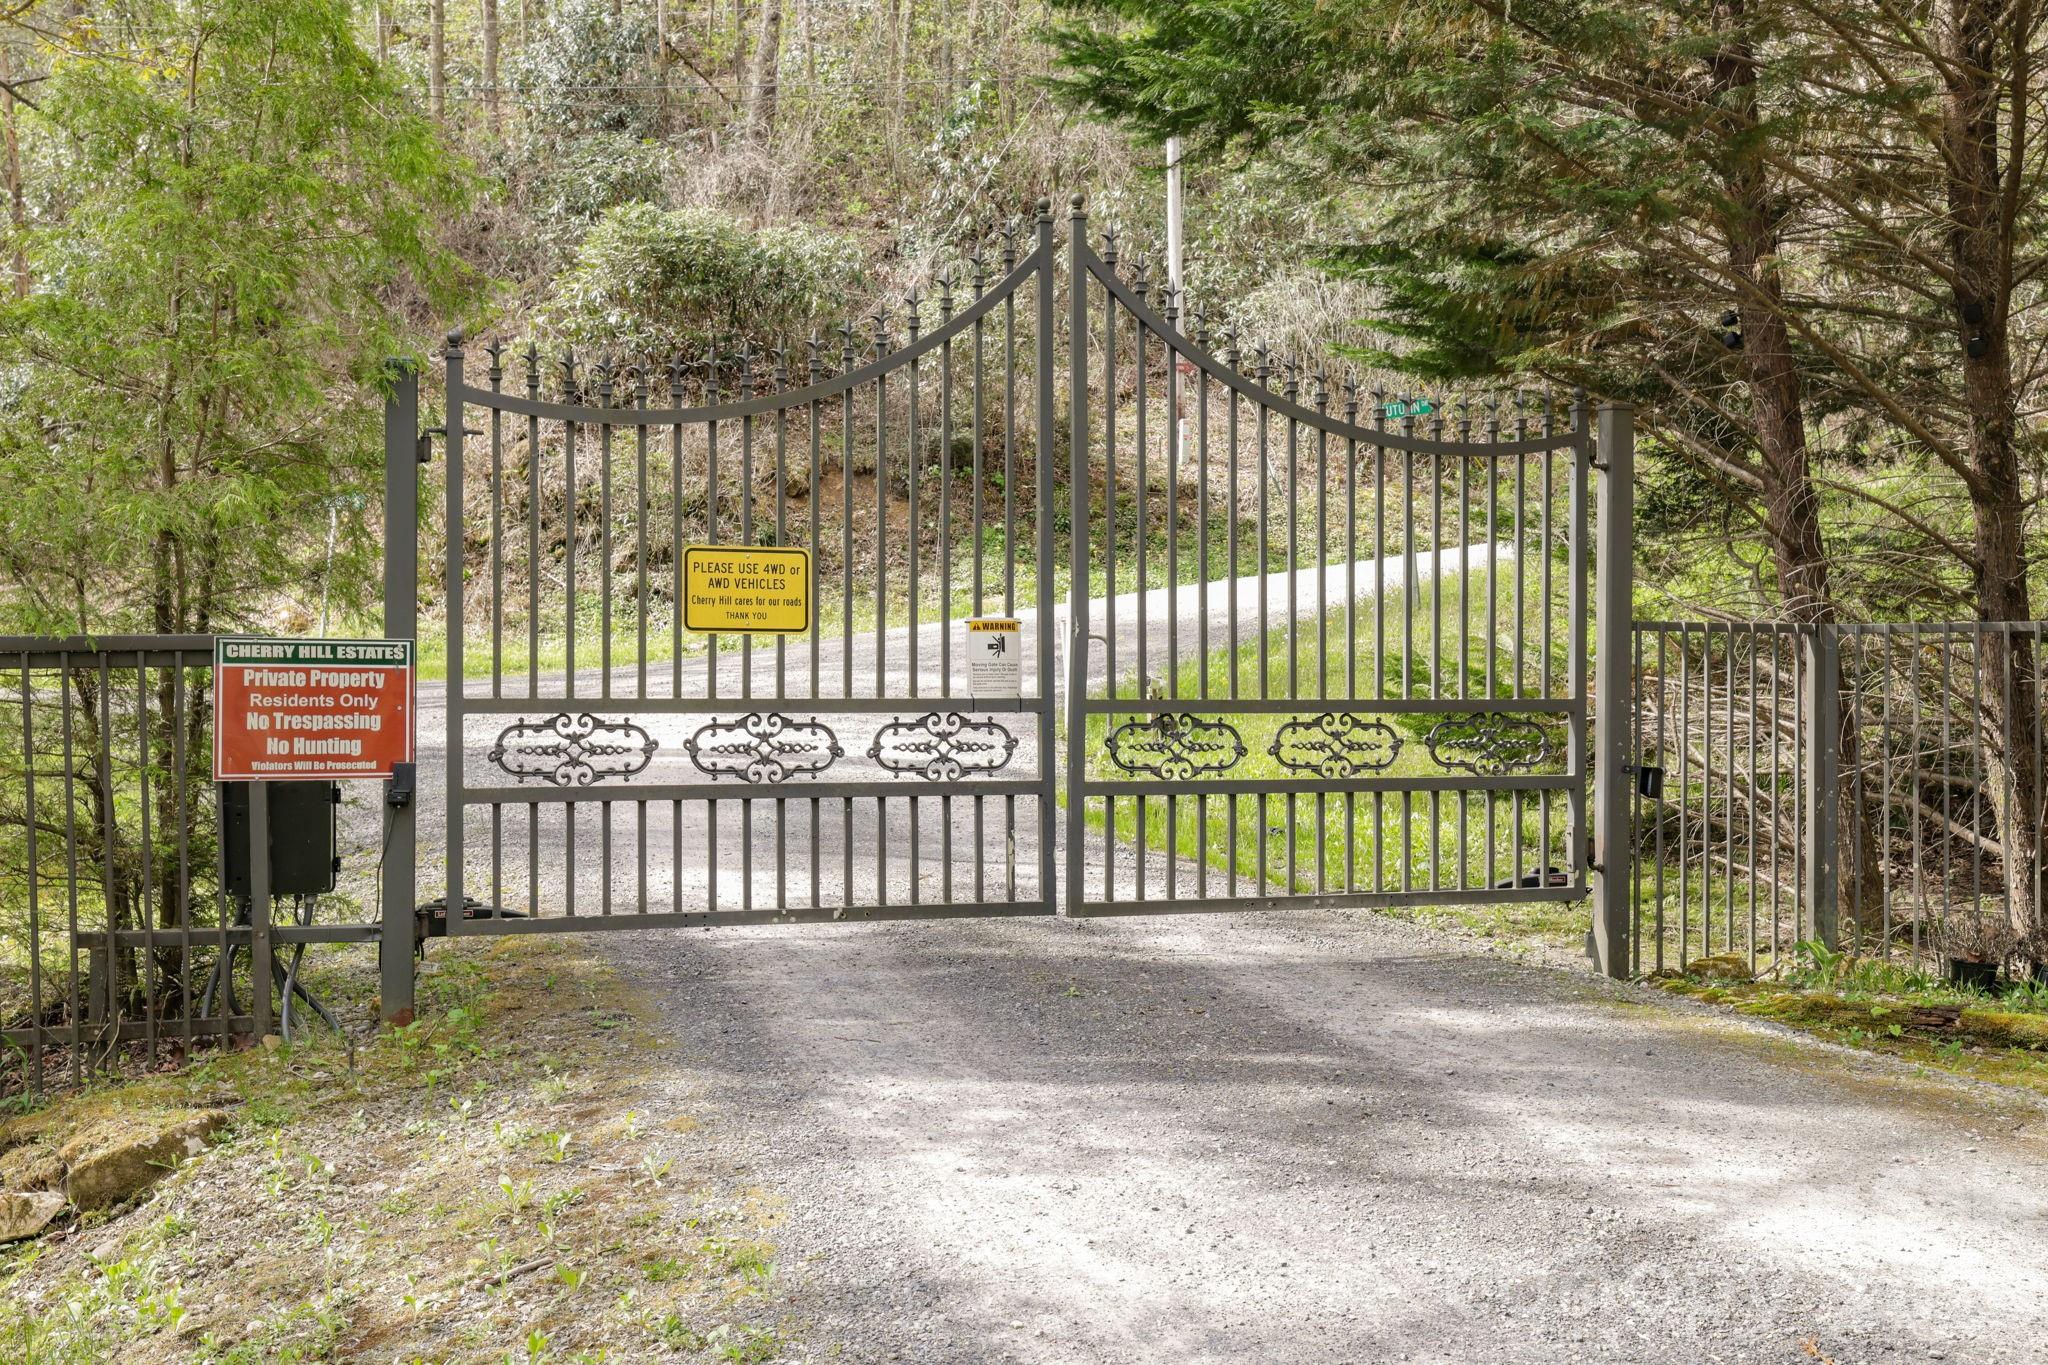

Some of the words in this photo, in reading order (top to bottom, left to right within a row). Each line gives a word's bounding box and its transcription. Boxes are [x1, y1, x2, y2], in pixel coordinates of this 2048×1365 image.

[693, 562, 734, 574] PLEASE
[738, 563, 759, 574] USE
[763, 564, 786, 575] 4WD
[790, 566, 801, 575] or
[708, 578, 730, 589] AWD
[734, 578, 786, 590] VEHICLES
[691, 595, 716, 607] Cherry
[719, 595, 732, 605] Hill
[735, 597, 753, 606] cares
[756, 596, 765, 606] for
[768, 598, 780, 606] our
[783, 597, 802, 607] roads
[726, 611, 750, 620] THANK
[752, 612, 767, 620] YOU
[982, 622, 1016, 631] WARNING
[226, 644, 296, 659] CHERRY
[299, 645, 333, 659] HILL
[336, 646, 404, 660] ESTATES
[243, 669, 307, 687] Private
[310, 669, 386, 689] Property
[250, 693, 335, 707] Residents
[340, 694, 378, 710] Only
[246, 712, 270, 730] No
[273, 712, 382, 731] Trespassing
[266, 738, 290, 755] No
[293, 737, 362, 756] Hunting
[252, 761, 293, 771] Violators
[294, 761, 312, 770] Will
[314, 761, 325, 770] Be
[326, 760, 377, 770] Prosecuted
